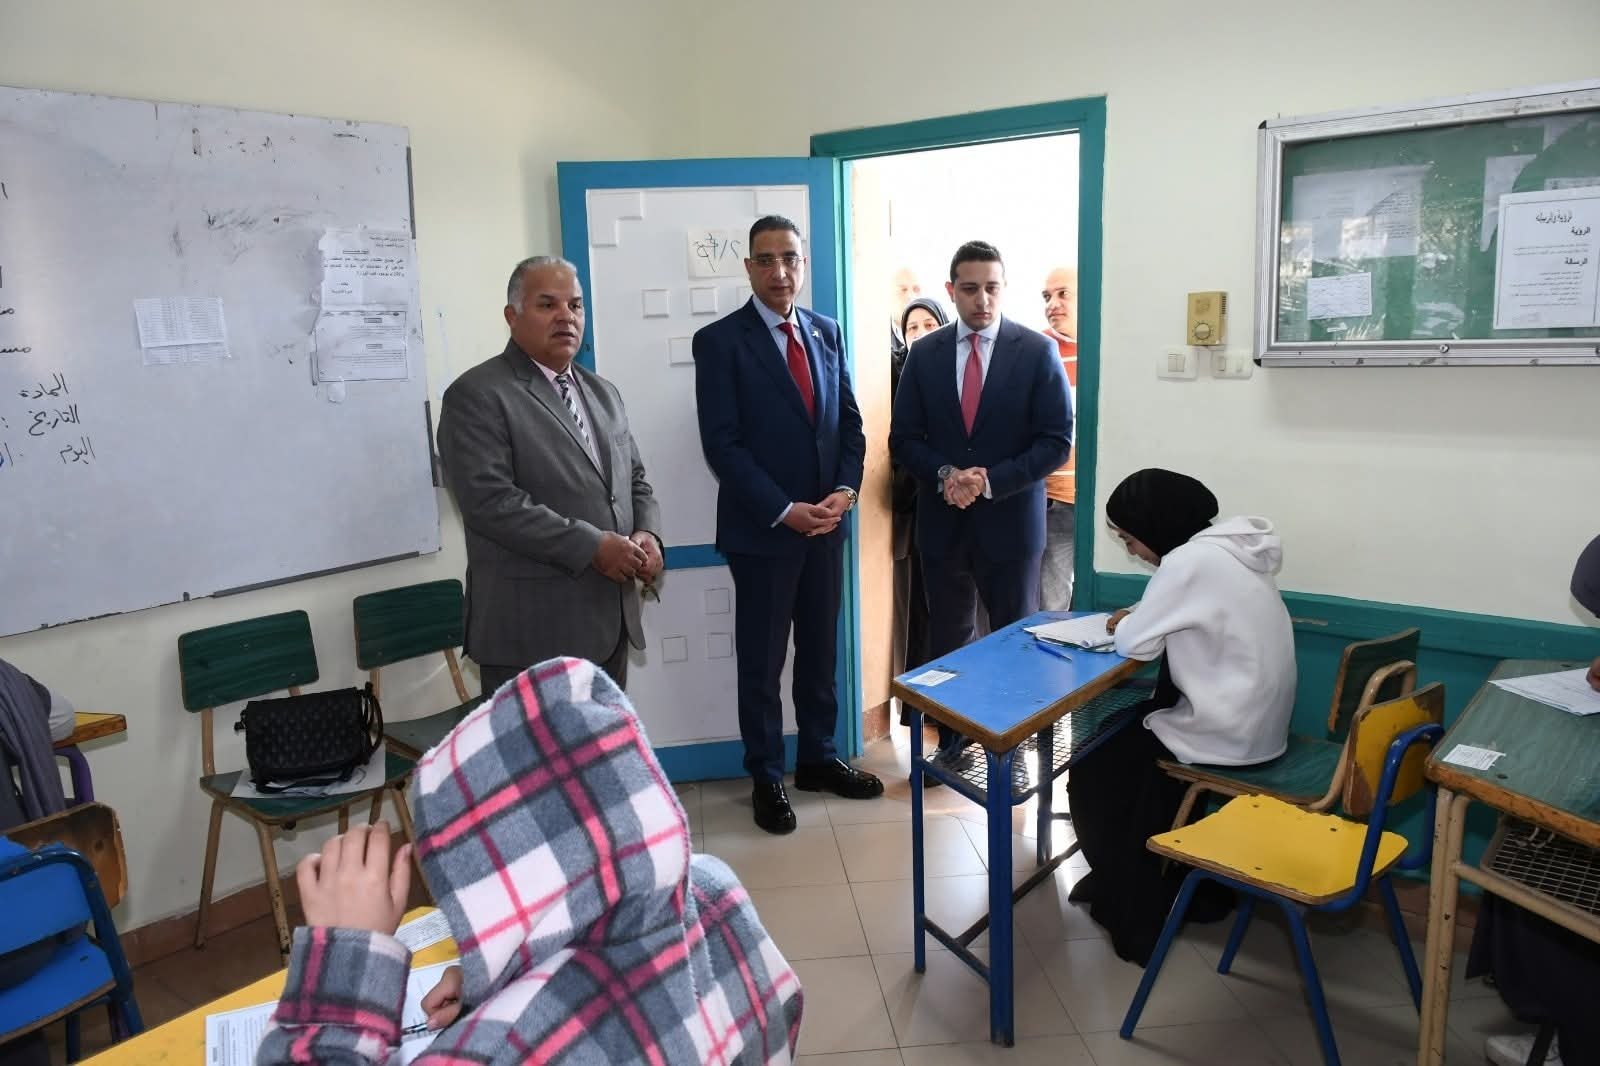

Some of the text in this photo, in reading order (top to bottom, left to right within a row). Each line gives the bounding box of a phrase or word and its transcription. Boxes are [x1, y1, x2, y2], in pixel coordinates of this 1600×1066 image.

[19, 372, 70, 400] المادة
[27, 403, 81, 437] التاريخ
[59, 436, 97, 465] اليوم
